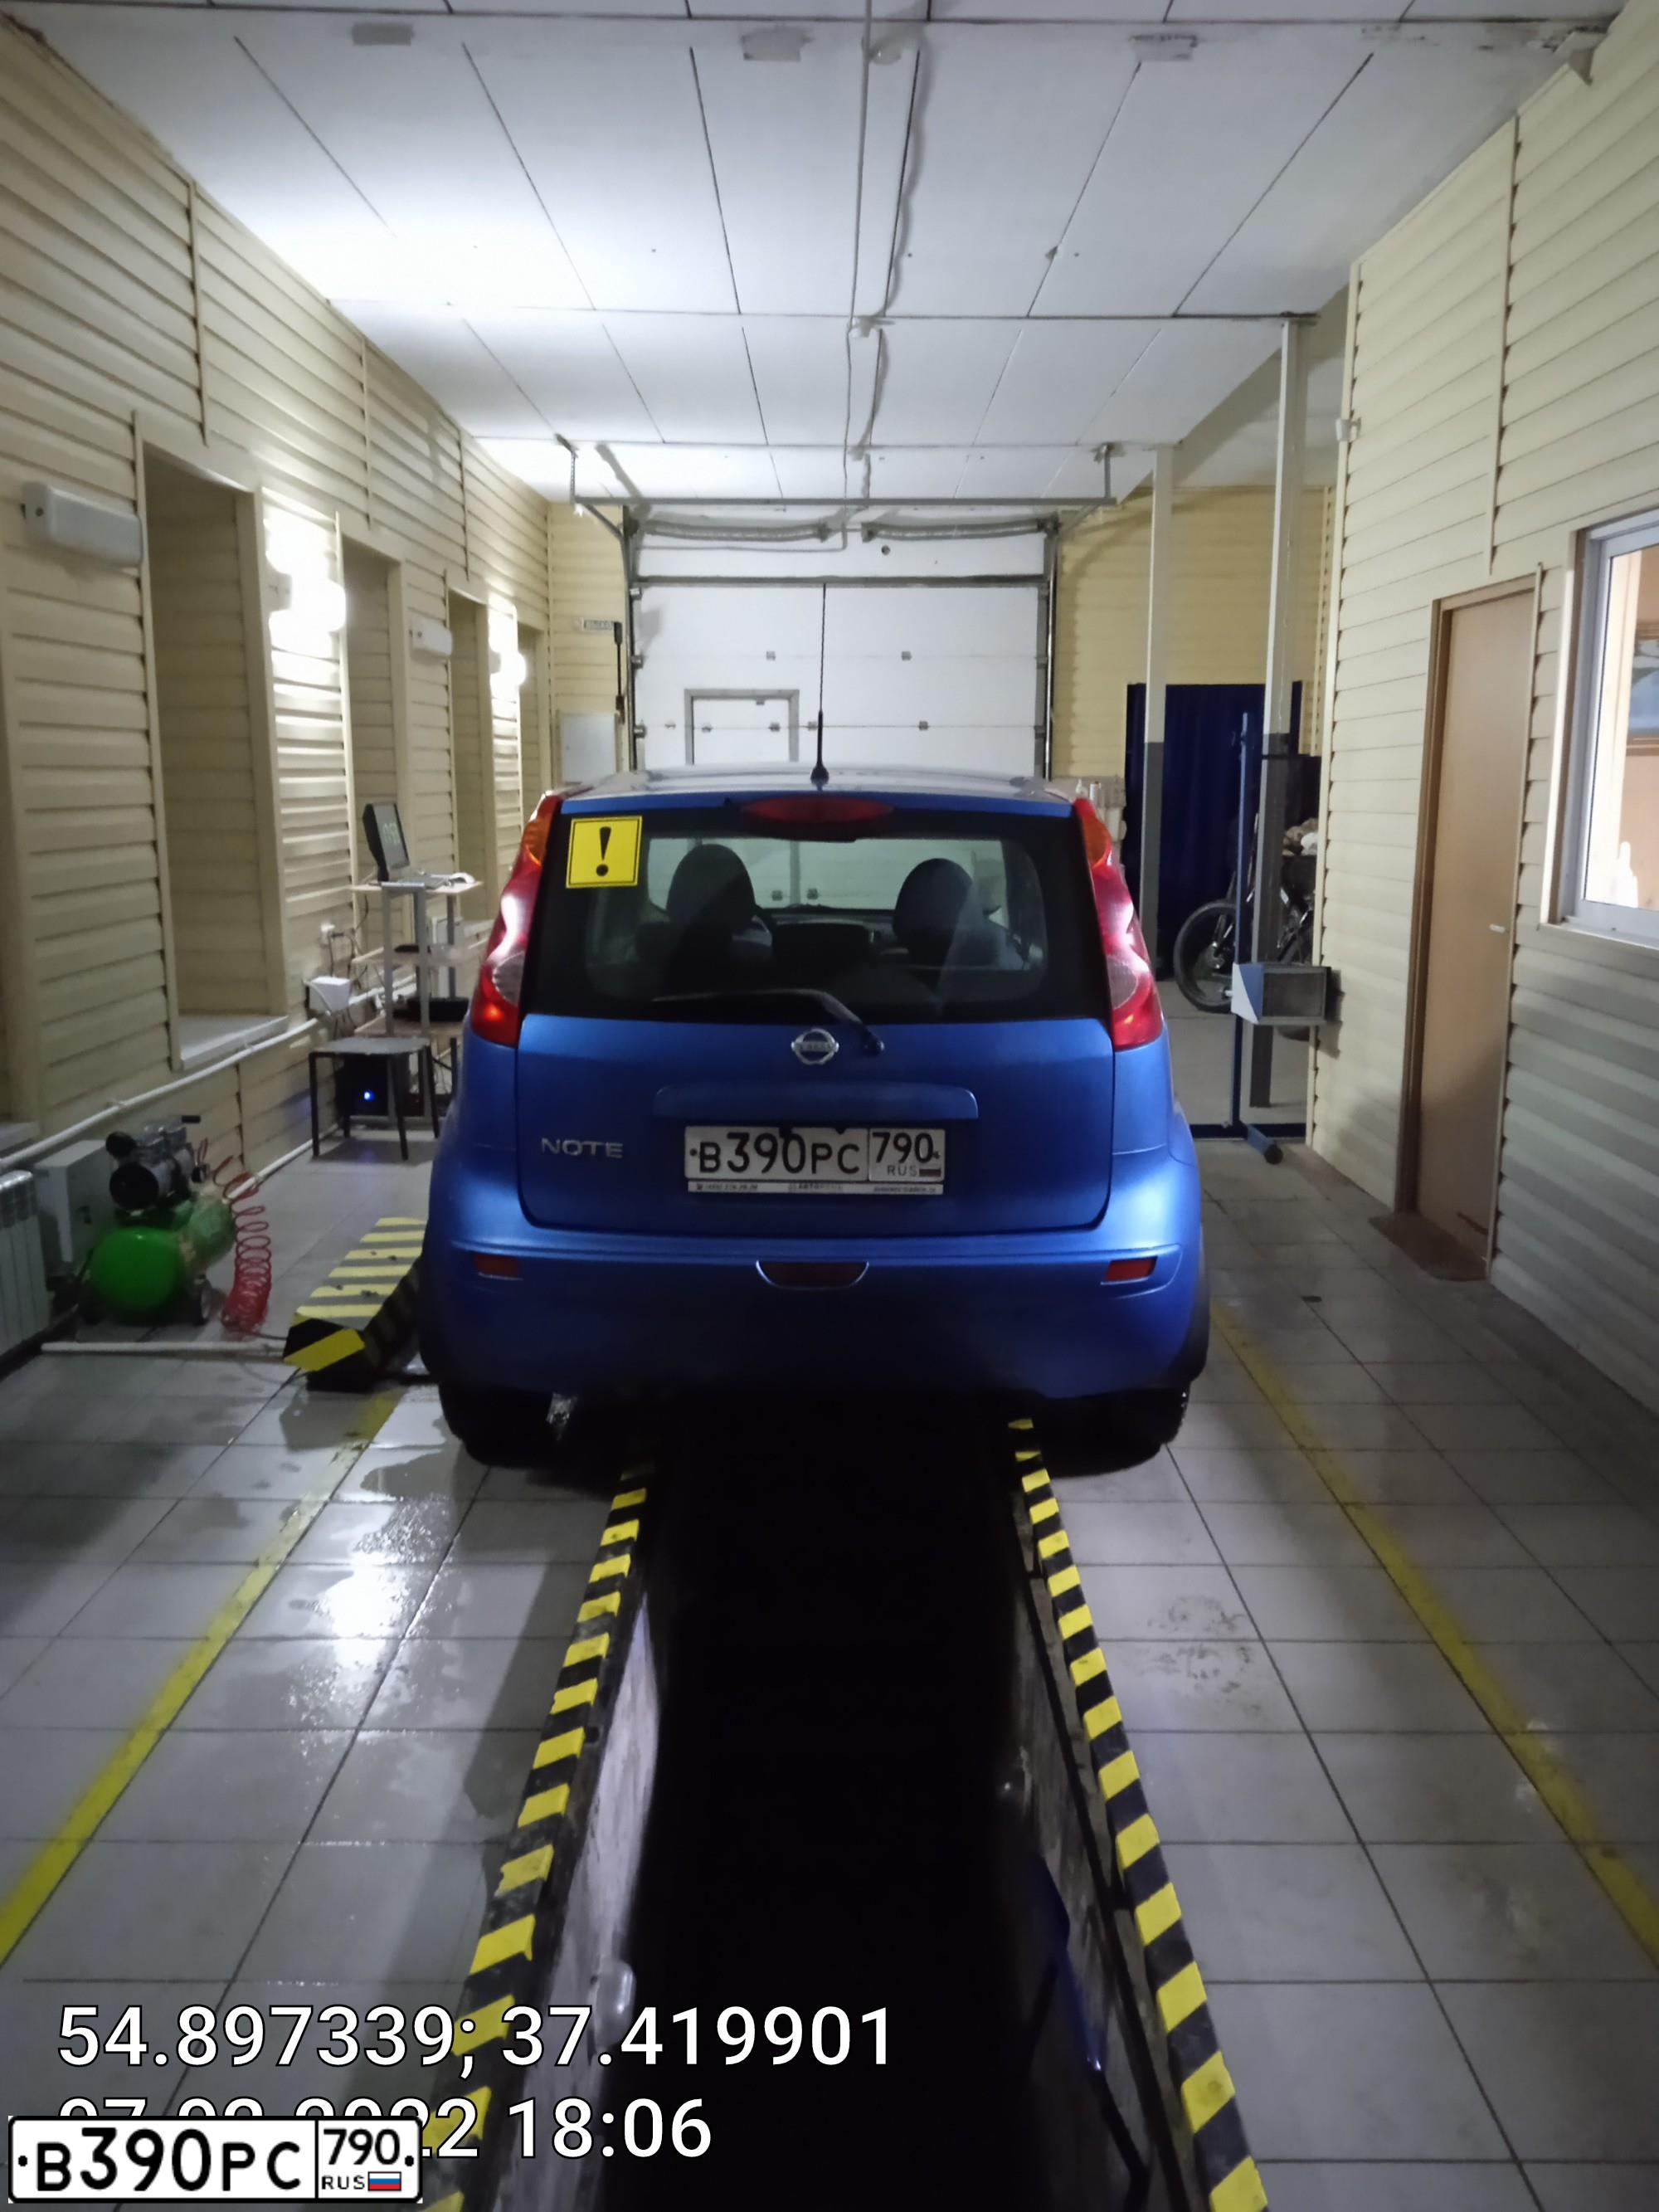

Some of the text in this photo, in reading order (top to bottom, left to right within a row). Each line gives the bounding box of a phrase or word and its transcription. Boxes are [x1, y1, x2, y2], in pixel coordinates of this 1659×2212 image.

[541, 1138, 623, 1158] NOTE
[699, 1132, 933, 1175] В390РС 790
[887, 1165, 917, 1177] RUS
